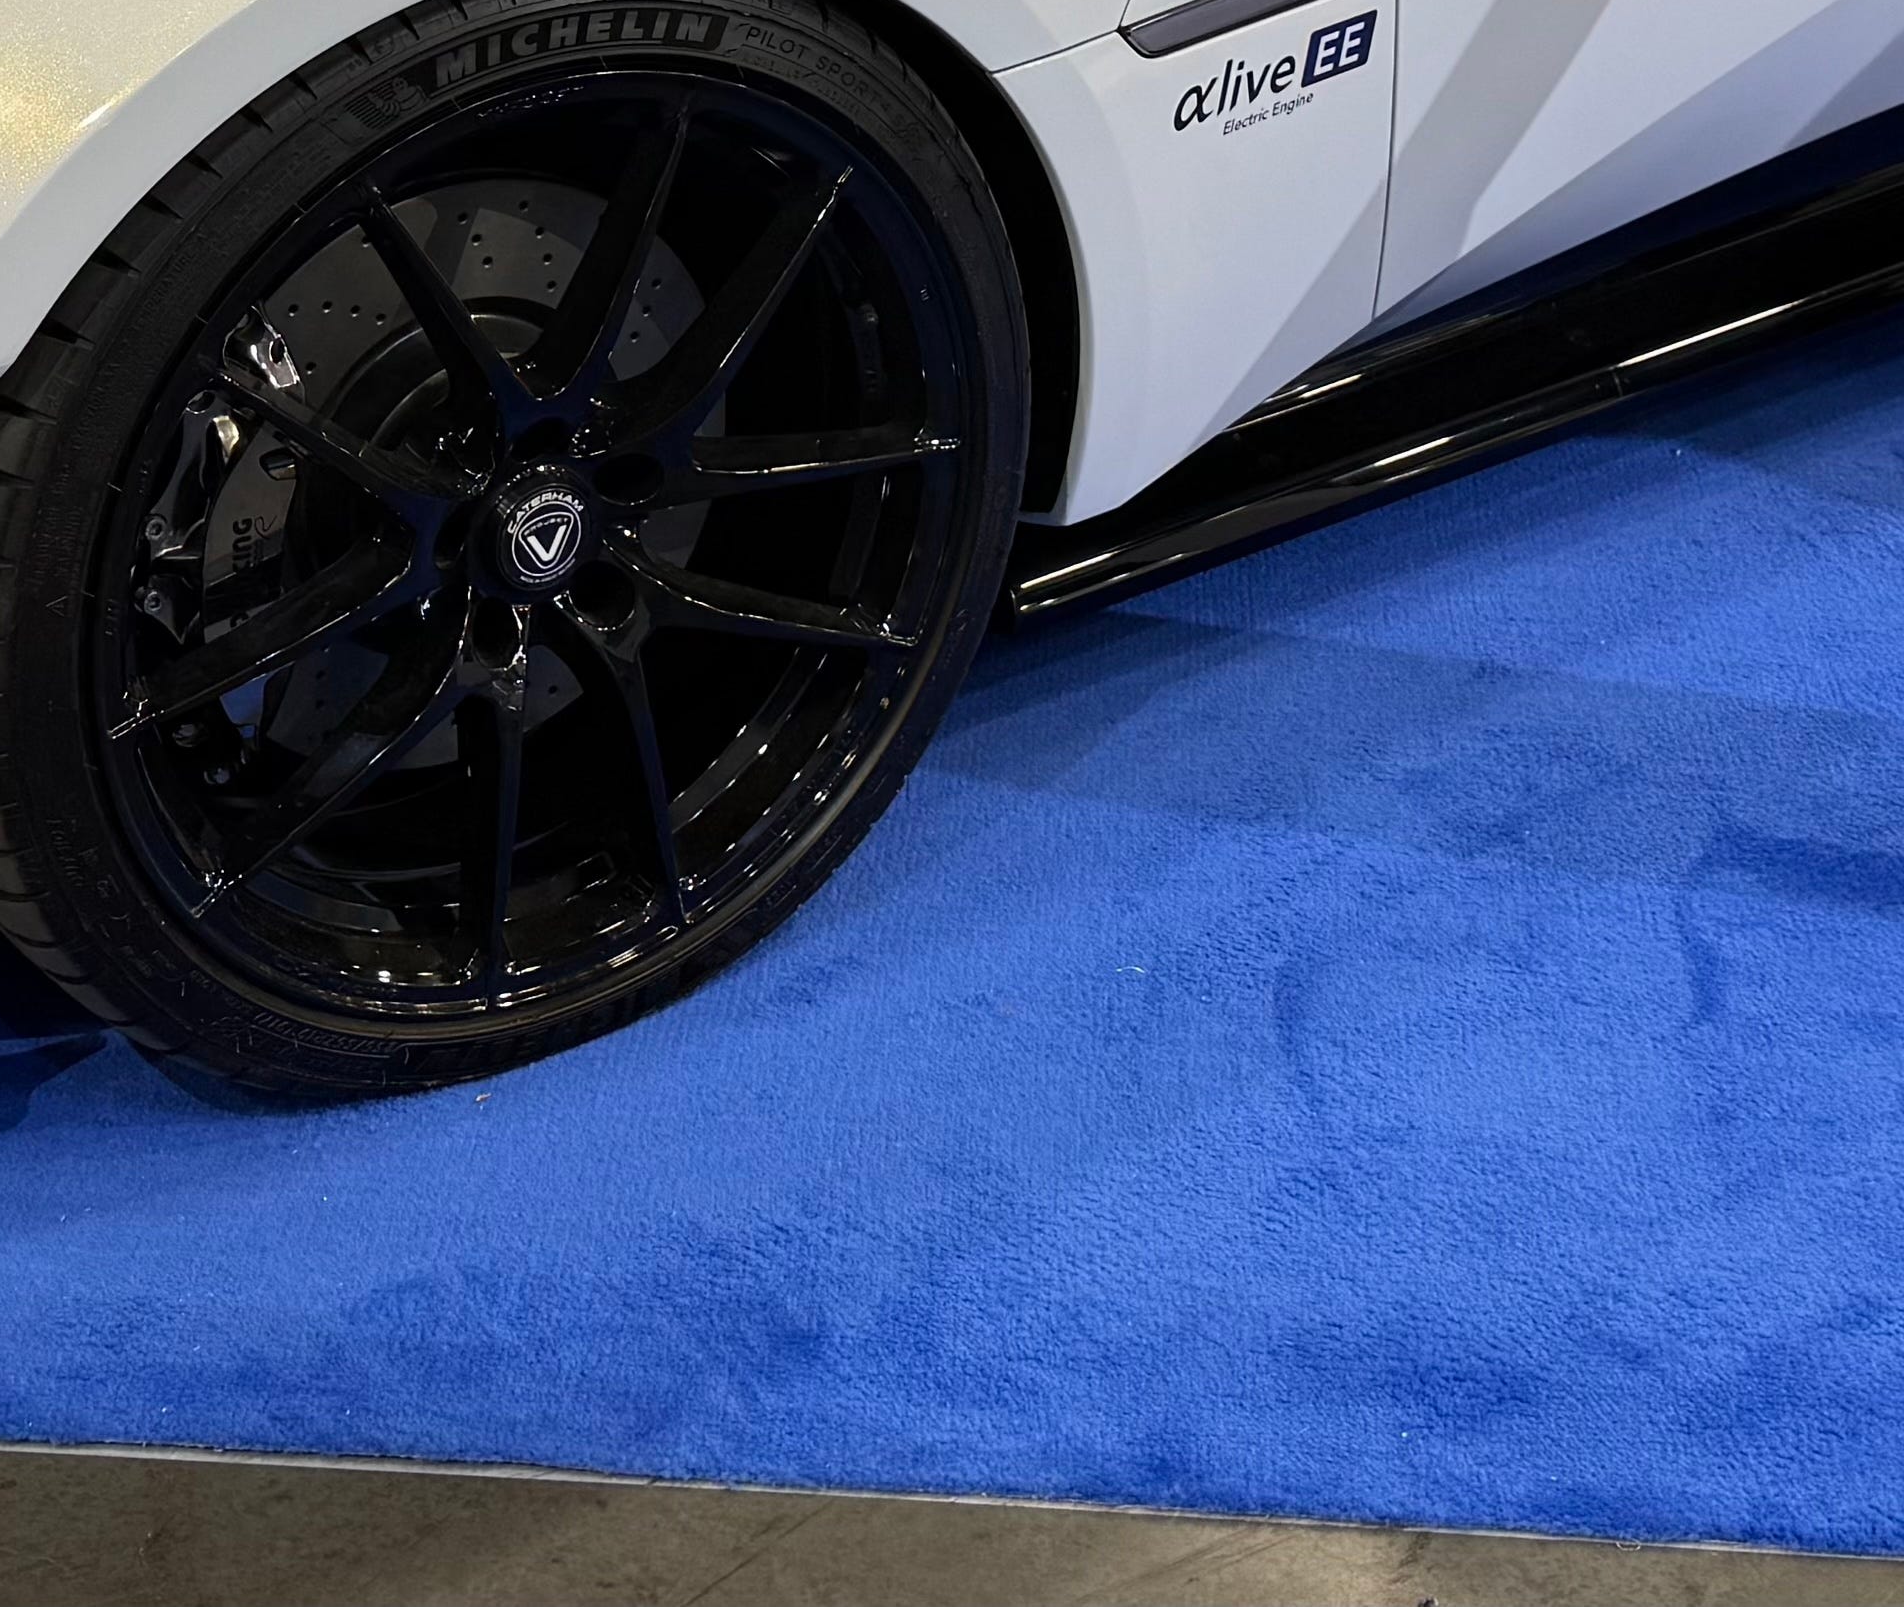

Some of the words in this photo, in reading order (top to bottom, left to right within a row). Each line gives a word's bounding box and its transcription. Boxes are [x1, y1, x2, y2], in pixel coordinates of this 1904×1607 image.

[435, 10, 710, 89] MICHELIN
[745, 26, 810, 60] PILOT
[815, 55, 880, 104] SPORT
[1222, 107, 1269, 136] Electric
[1271, 92, 1314, 117] Engine
